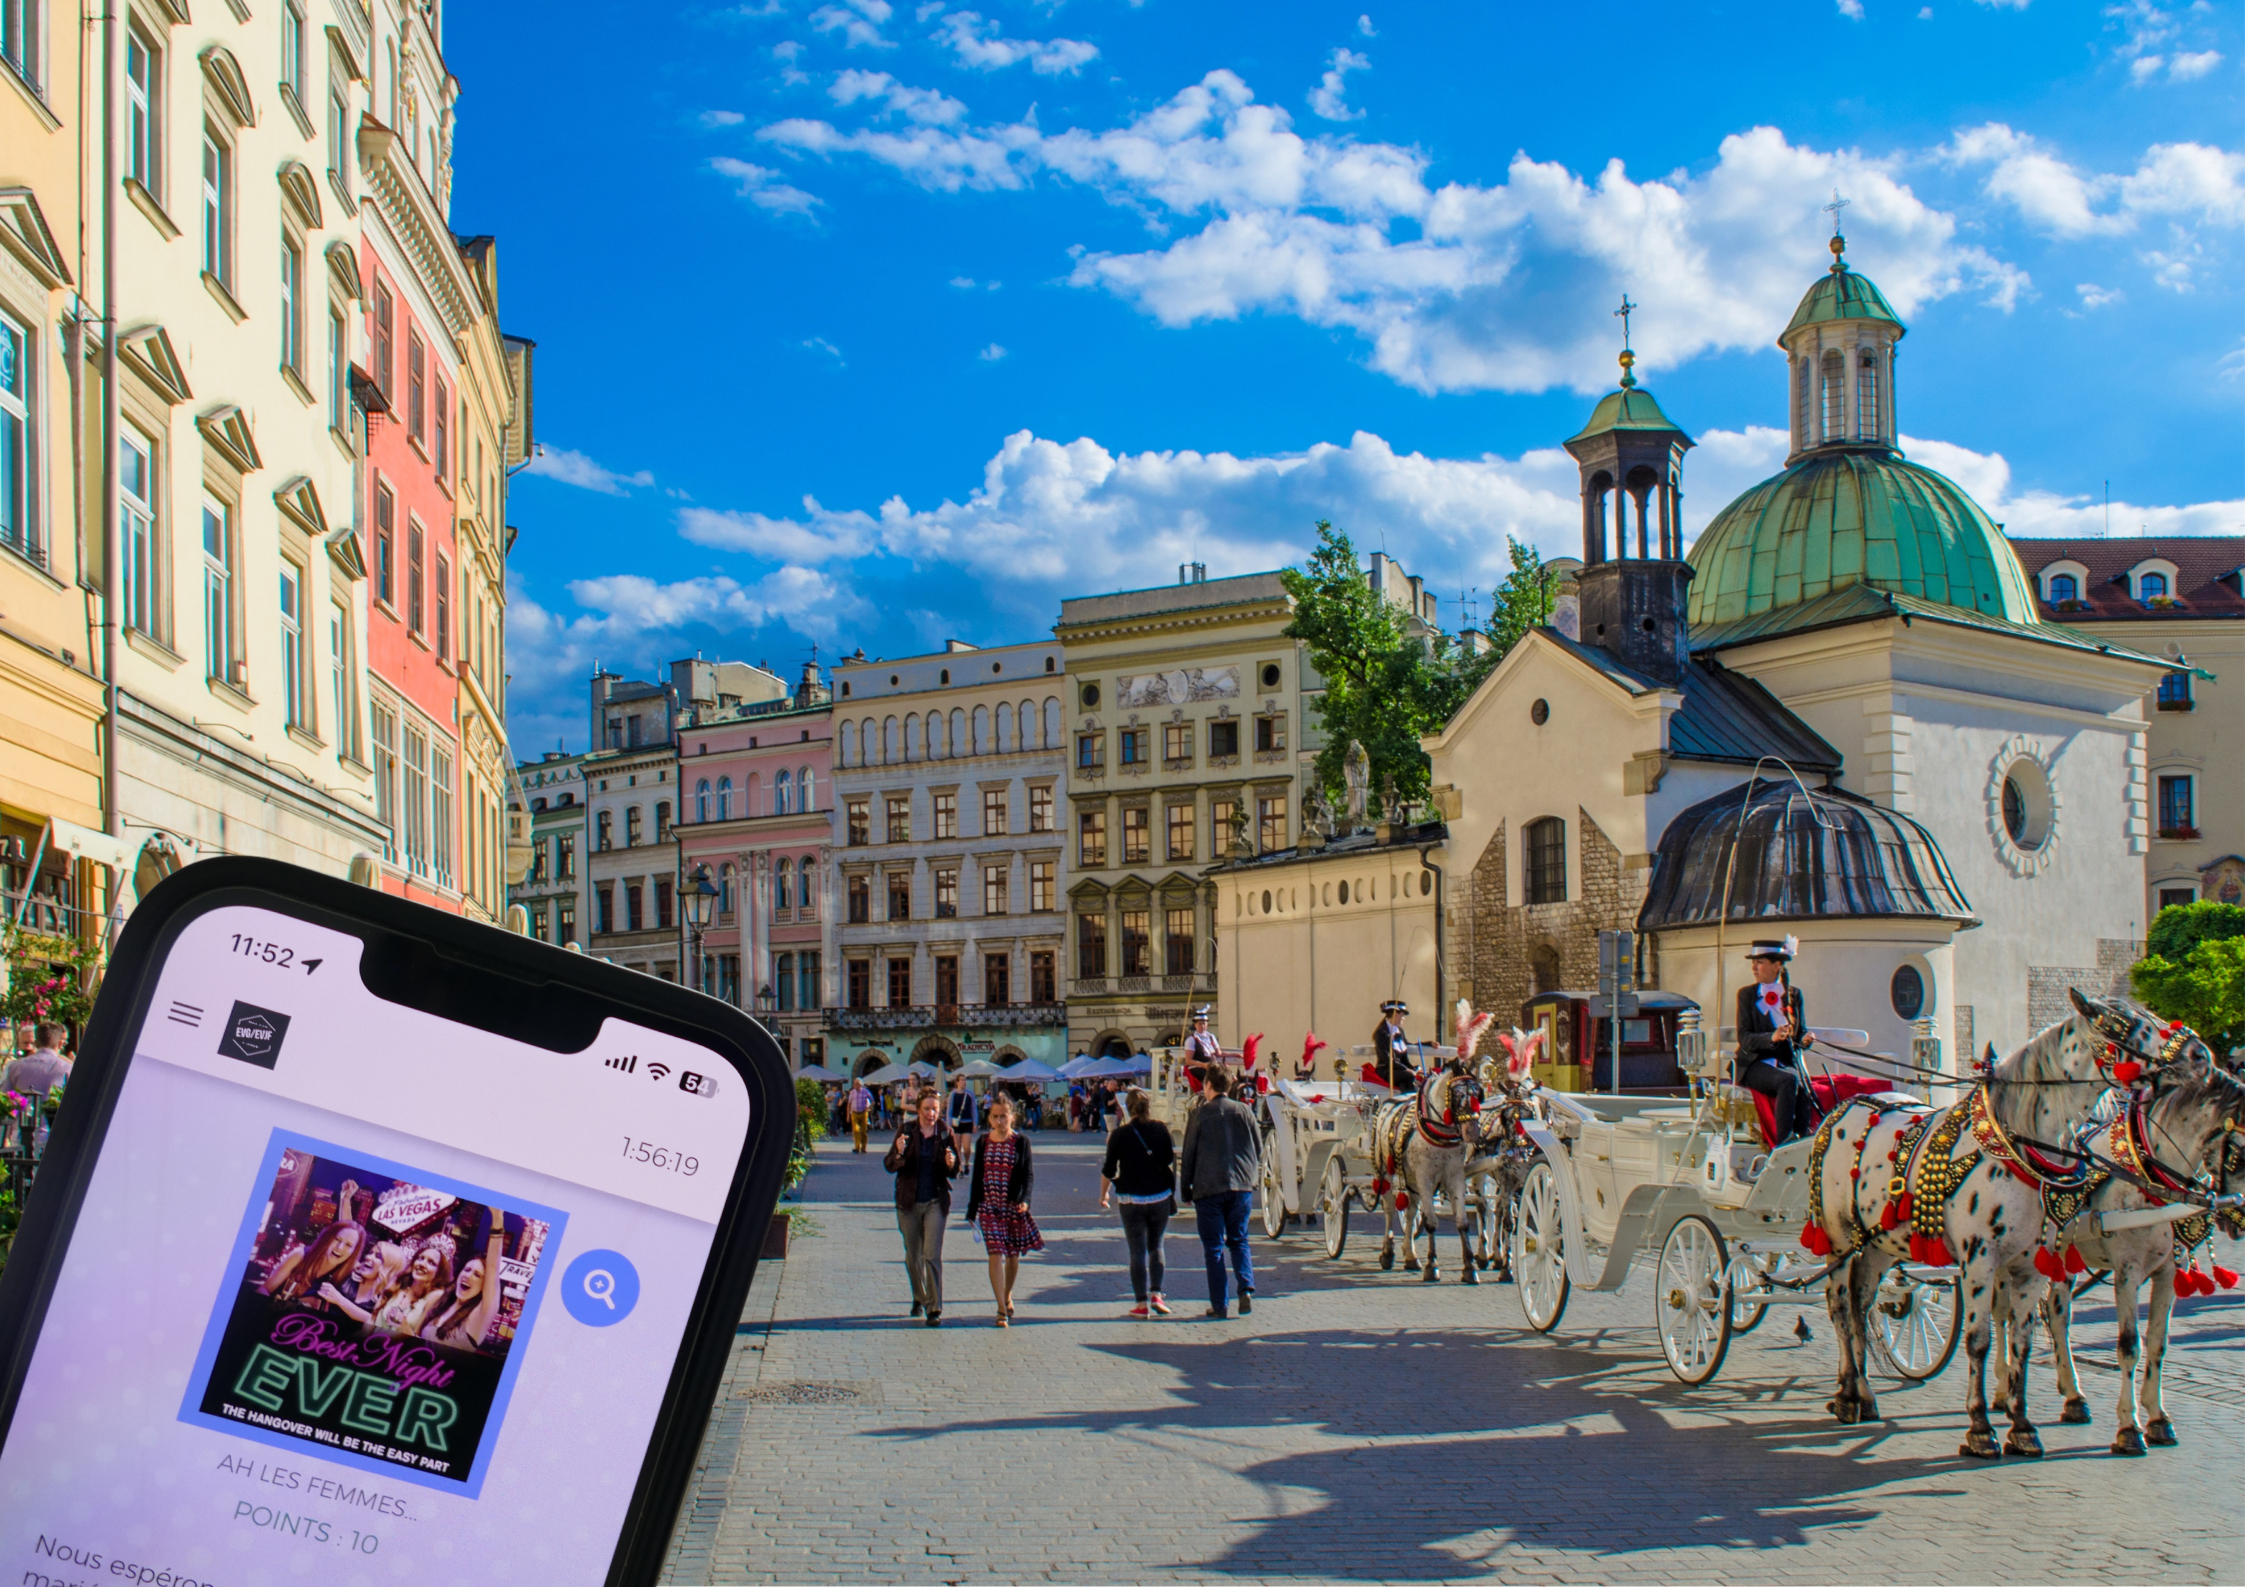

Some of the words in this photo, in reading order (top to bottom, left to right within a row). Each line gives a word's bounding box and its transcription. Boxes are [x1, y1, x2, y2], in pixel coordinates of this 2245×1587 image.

[232, 934, 294, 968] 11:52
[236, 1027, 273, 1040] EVG/EVJF
[685, 1074, 710, 1094] 54
[623, 1136, 699, 1176] 1:56:19
[378, 1207, 395, 1221] LAS
[399, 1199, 441, 1217] VEGAS
[391, 1217, 415, 1225] NEVADA
[270, 1313, 356, 1362] Best
[352, 1333, 455, 1392] Night
[234, 1343, 458, 1452] EVER
[222, 1403, 245, 1419] THE
[247, 1412, 313, 1436] HANGOVER
[314, 1429, 341, 1444] WILL
[342, 1436, 360, 1450] BE
[362, 1441, 385, 1456] THE
[386, 1448, 418, 1465] EASY
[420, 1456, 450, 1473] PART
[217, 1454, 254, 1477] AH
[260, 1464, 302, 1489] LES
[307, 1477, 418, 1522] FEMMES...
[234, 1500, 332, 1542] POINTS
[351, 1530, 379, 1554] 10
[35, 1534, 103, 1569] Nous
